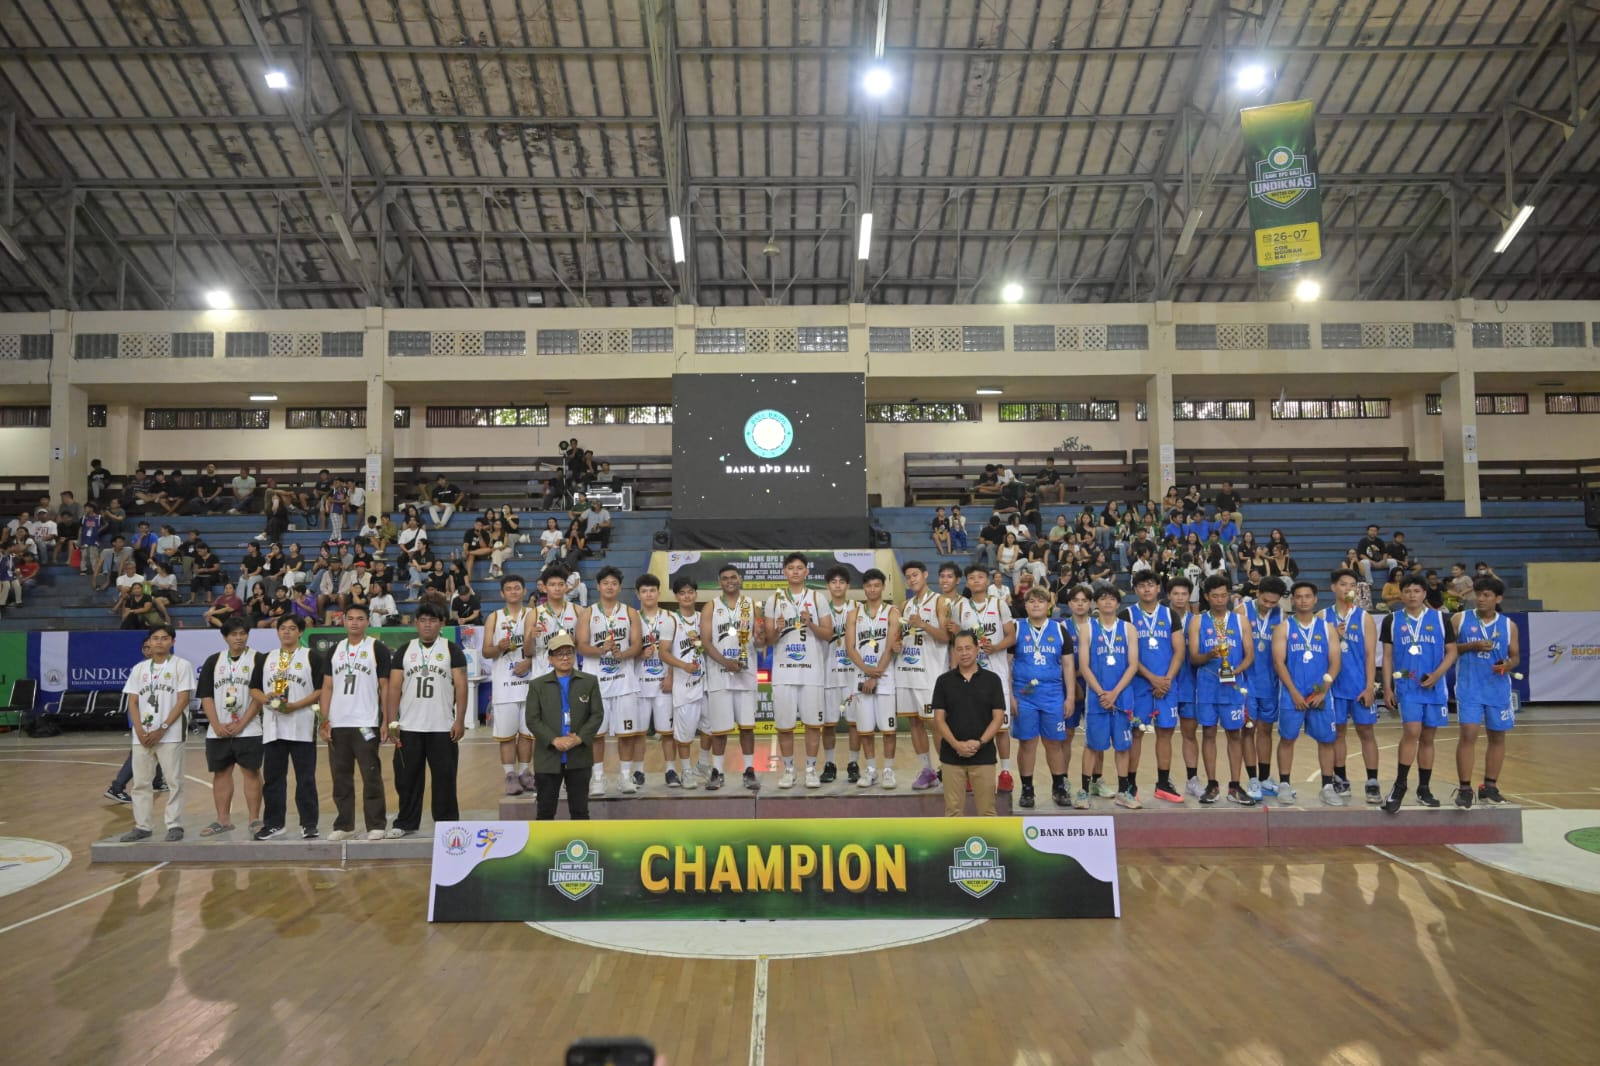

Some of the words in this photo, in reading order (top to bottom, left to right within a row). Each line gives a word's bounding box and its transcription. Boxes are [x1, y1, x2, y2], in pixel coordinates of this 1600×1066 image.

[1254, 176, 1312, 194] UNDIKNAS
[1274, 229, 1308, 242] 26-07
[725, 465, 756, 474] BANK
[759, 464, 781, 474] BPD
[785, 464, 810, 473] BALI
[800, 629, 807, 642] 5
[914, 634, 923, 646] 16
[785, 643, 806, 653] AQUA
[71, 667, 133, 680] UNDIK
[416, 676, 434, 698] 16
[818, 711, 823, 722] 5
[888, 716, 895, 728] 8
[624, 719, 633, 731] 13
[1040, 828, 1064, 837] BANK
[1067, 828, 1085, 837] BPD
[1087, 828, 1108, 837] BALI
[640, 843, 907, 893] CHAMPION
[952, 868, 1002, 880] UNDIKNAS
[552, 871, 601, 882] UNDIKNAS
